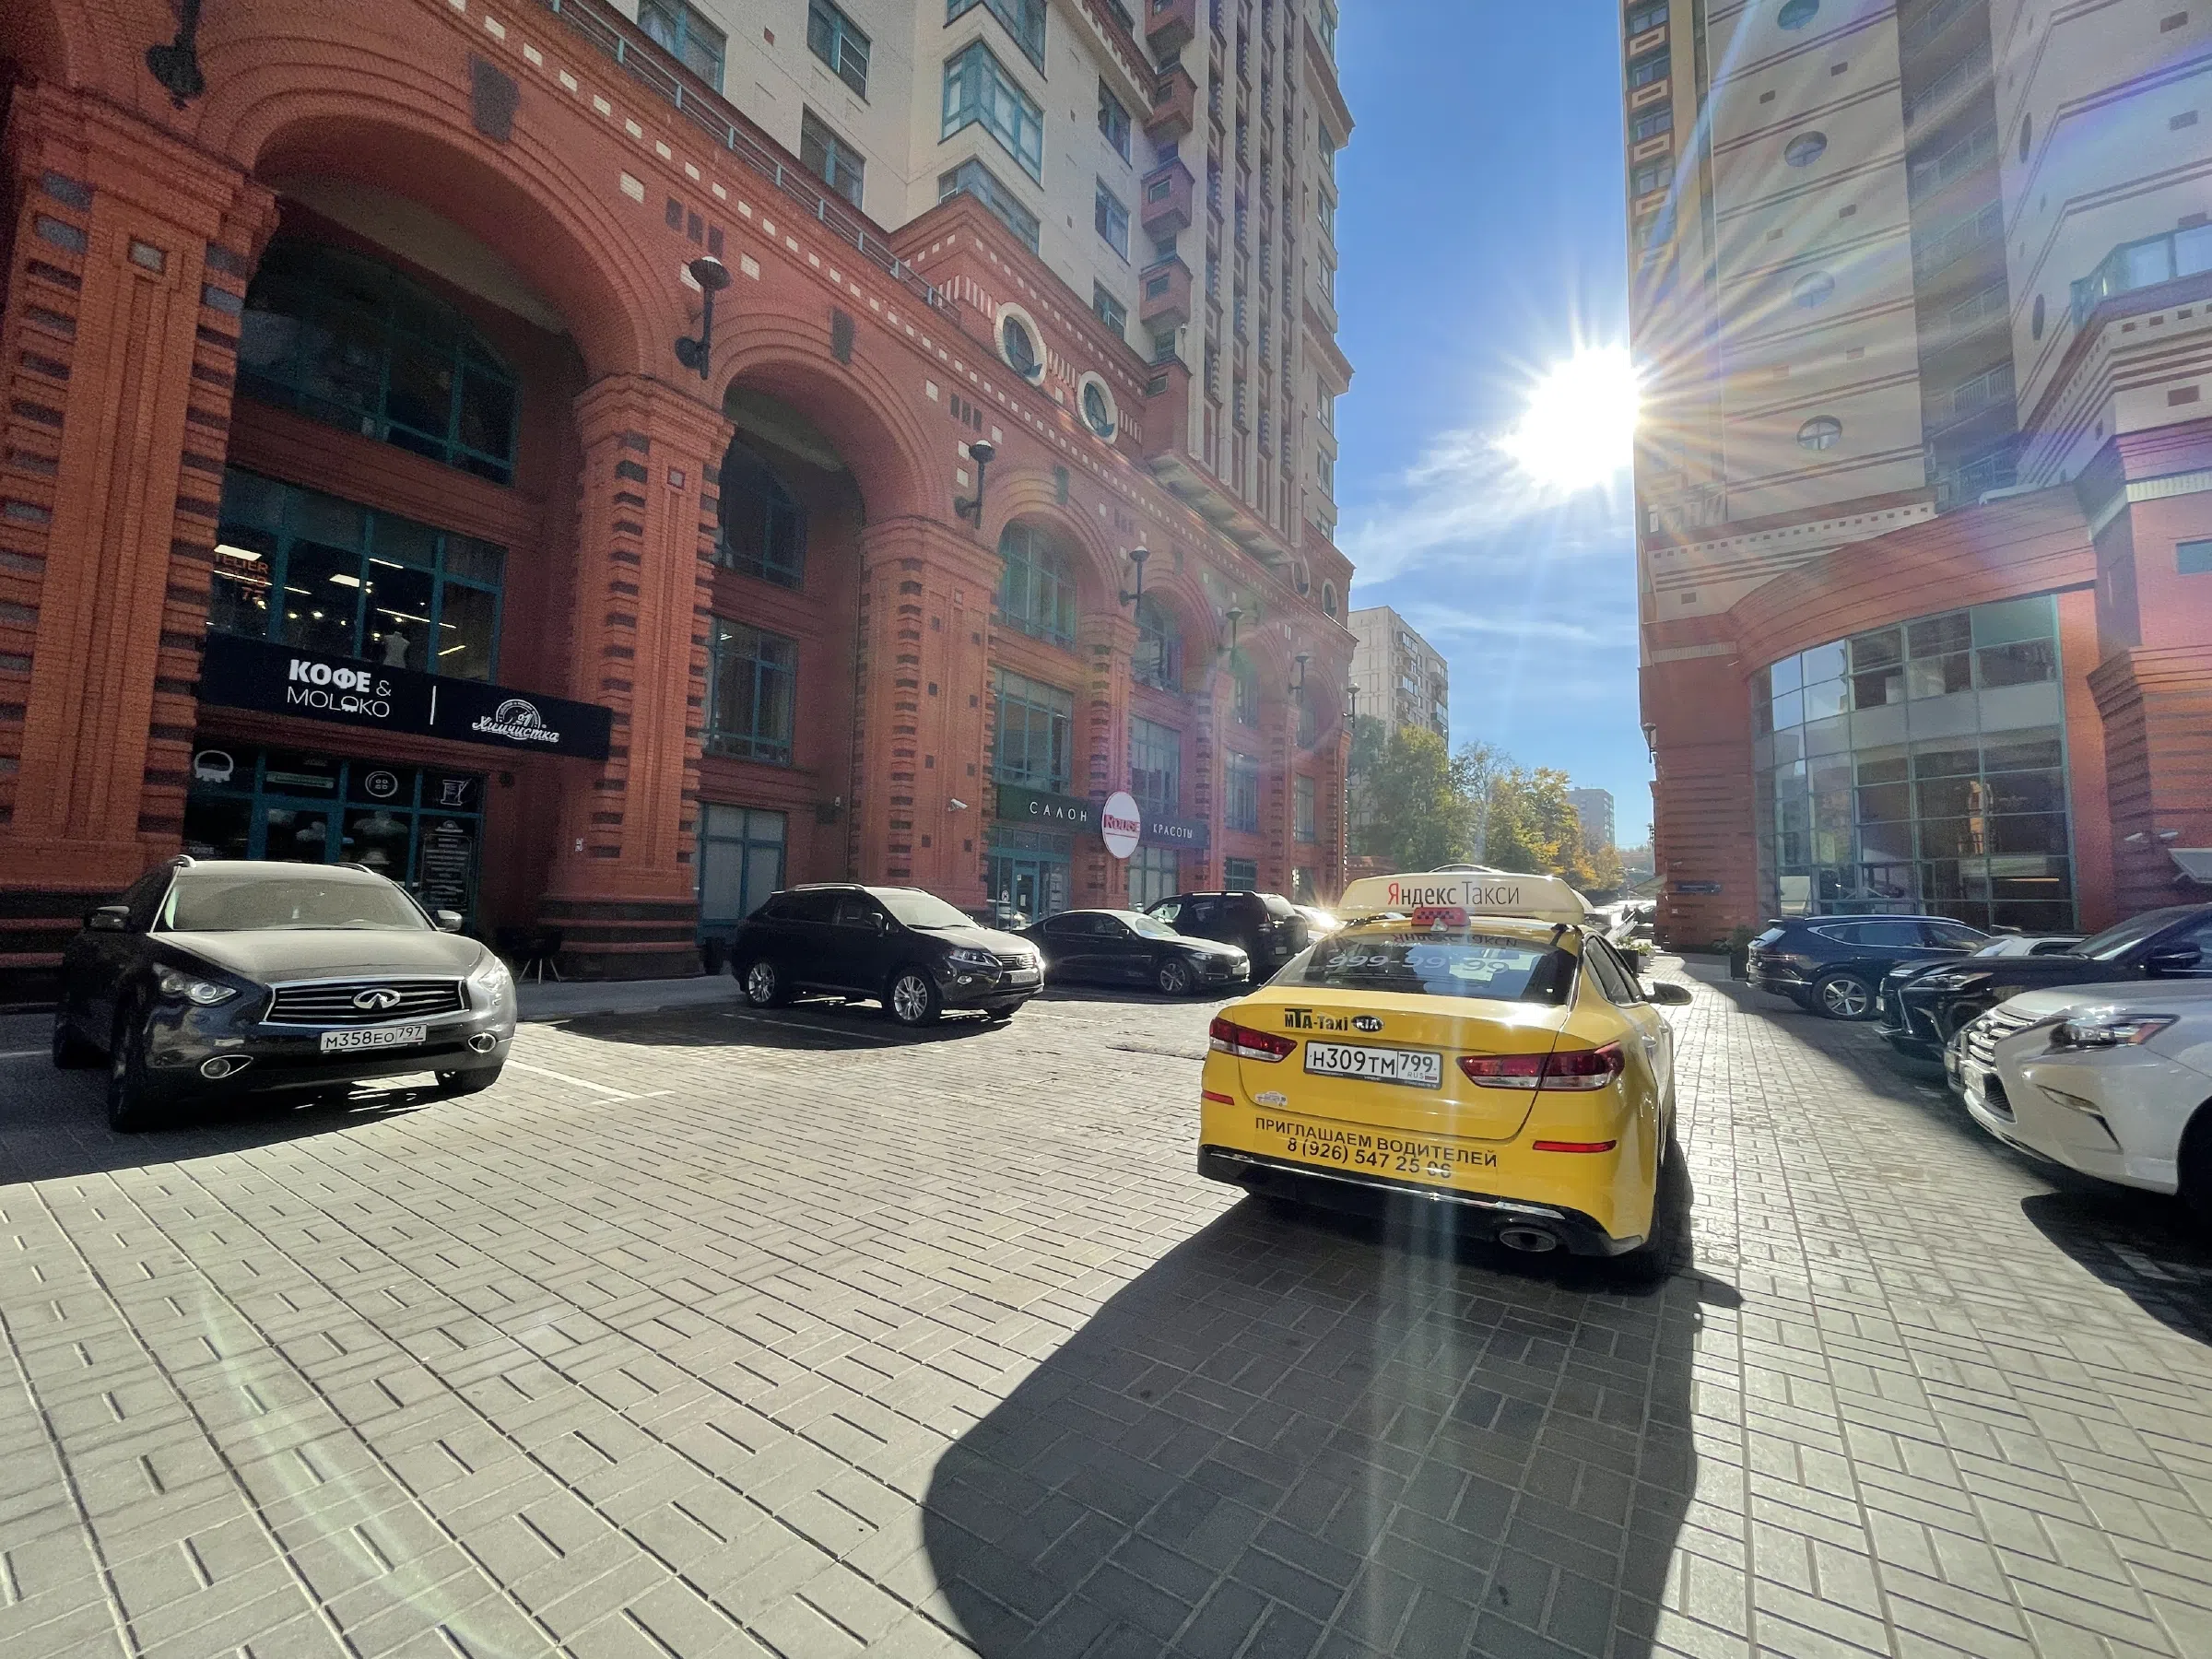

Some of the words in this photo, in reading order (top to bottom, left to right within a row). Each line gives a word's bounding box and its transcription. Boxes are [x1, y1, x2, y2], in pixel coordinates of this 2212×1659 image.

[289, 659, 371, 692] КОФЕ
[376, 680, 391, 696] &
[287, 686, 390, 717] MOLOKO
[472, 715, 560, 743] Химчистка
[1030, 801, 1088, 822] САЛОН
[1153, 823, 1193, 839] КРАСОТЫ
[1387, 883, 1457, 908] Яндекс
[1462, 881, 1520, 905] Такси
[1355, 1018, 1379, 1030] KIA
[1399, 1053, 1433, 1073] 799
[1407, 1071, 1425, 1079] RUS
[1255, 1117, 1371, 1148] ПРИГЛАШАЕМ
[1377, 1137, 1498, 1168] ВОДИТЕЛЕЙ
[1287, 1137, 1297, 1152] 8
[1301, 1140, 1348, 1164] (926)
[1354, 1149, 1390, 1169] 547
[1395, 1156, 1420, 1173] 25
